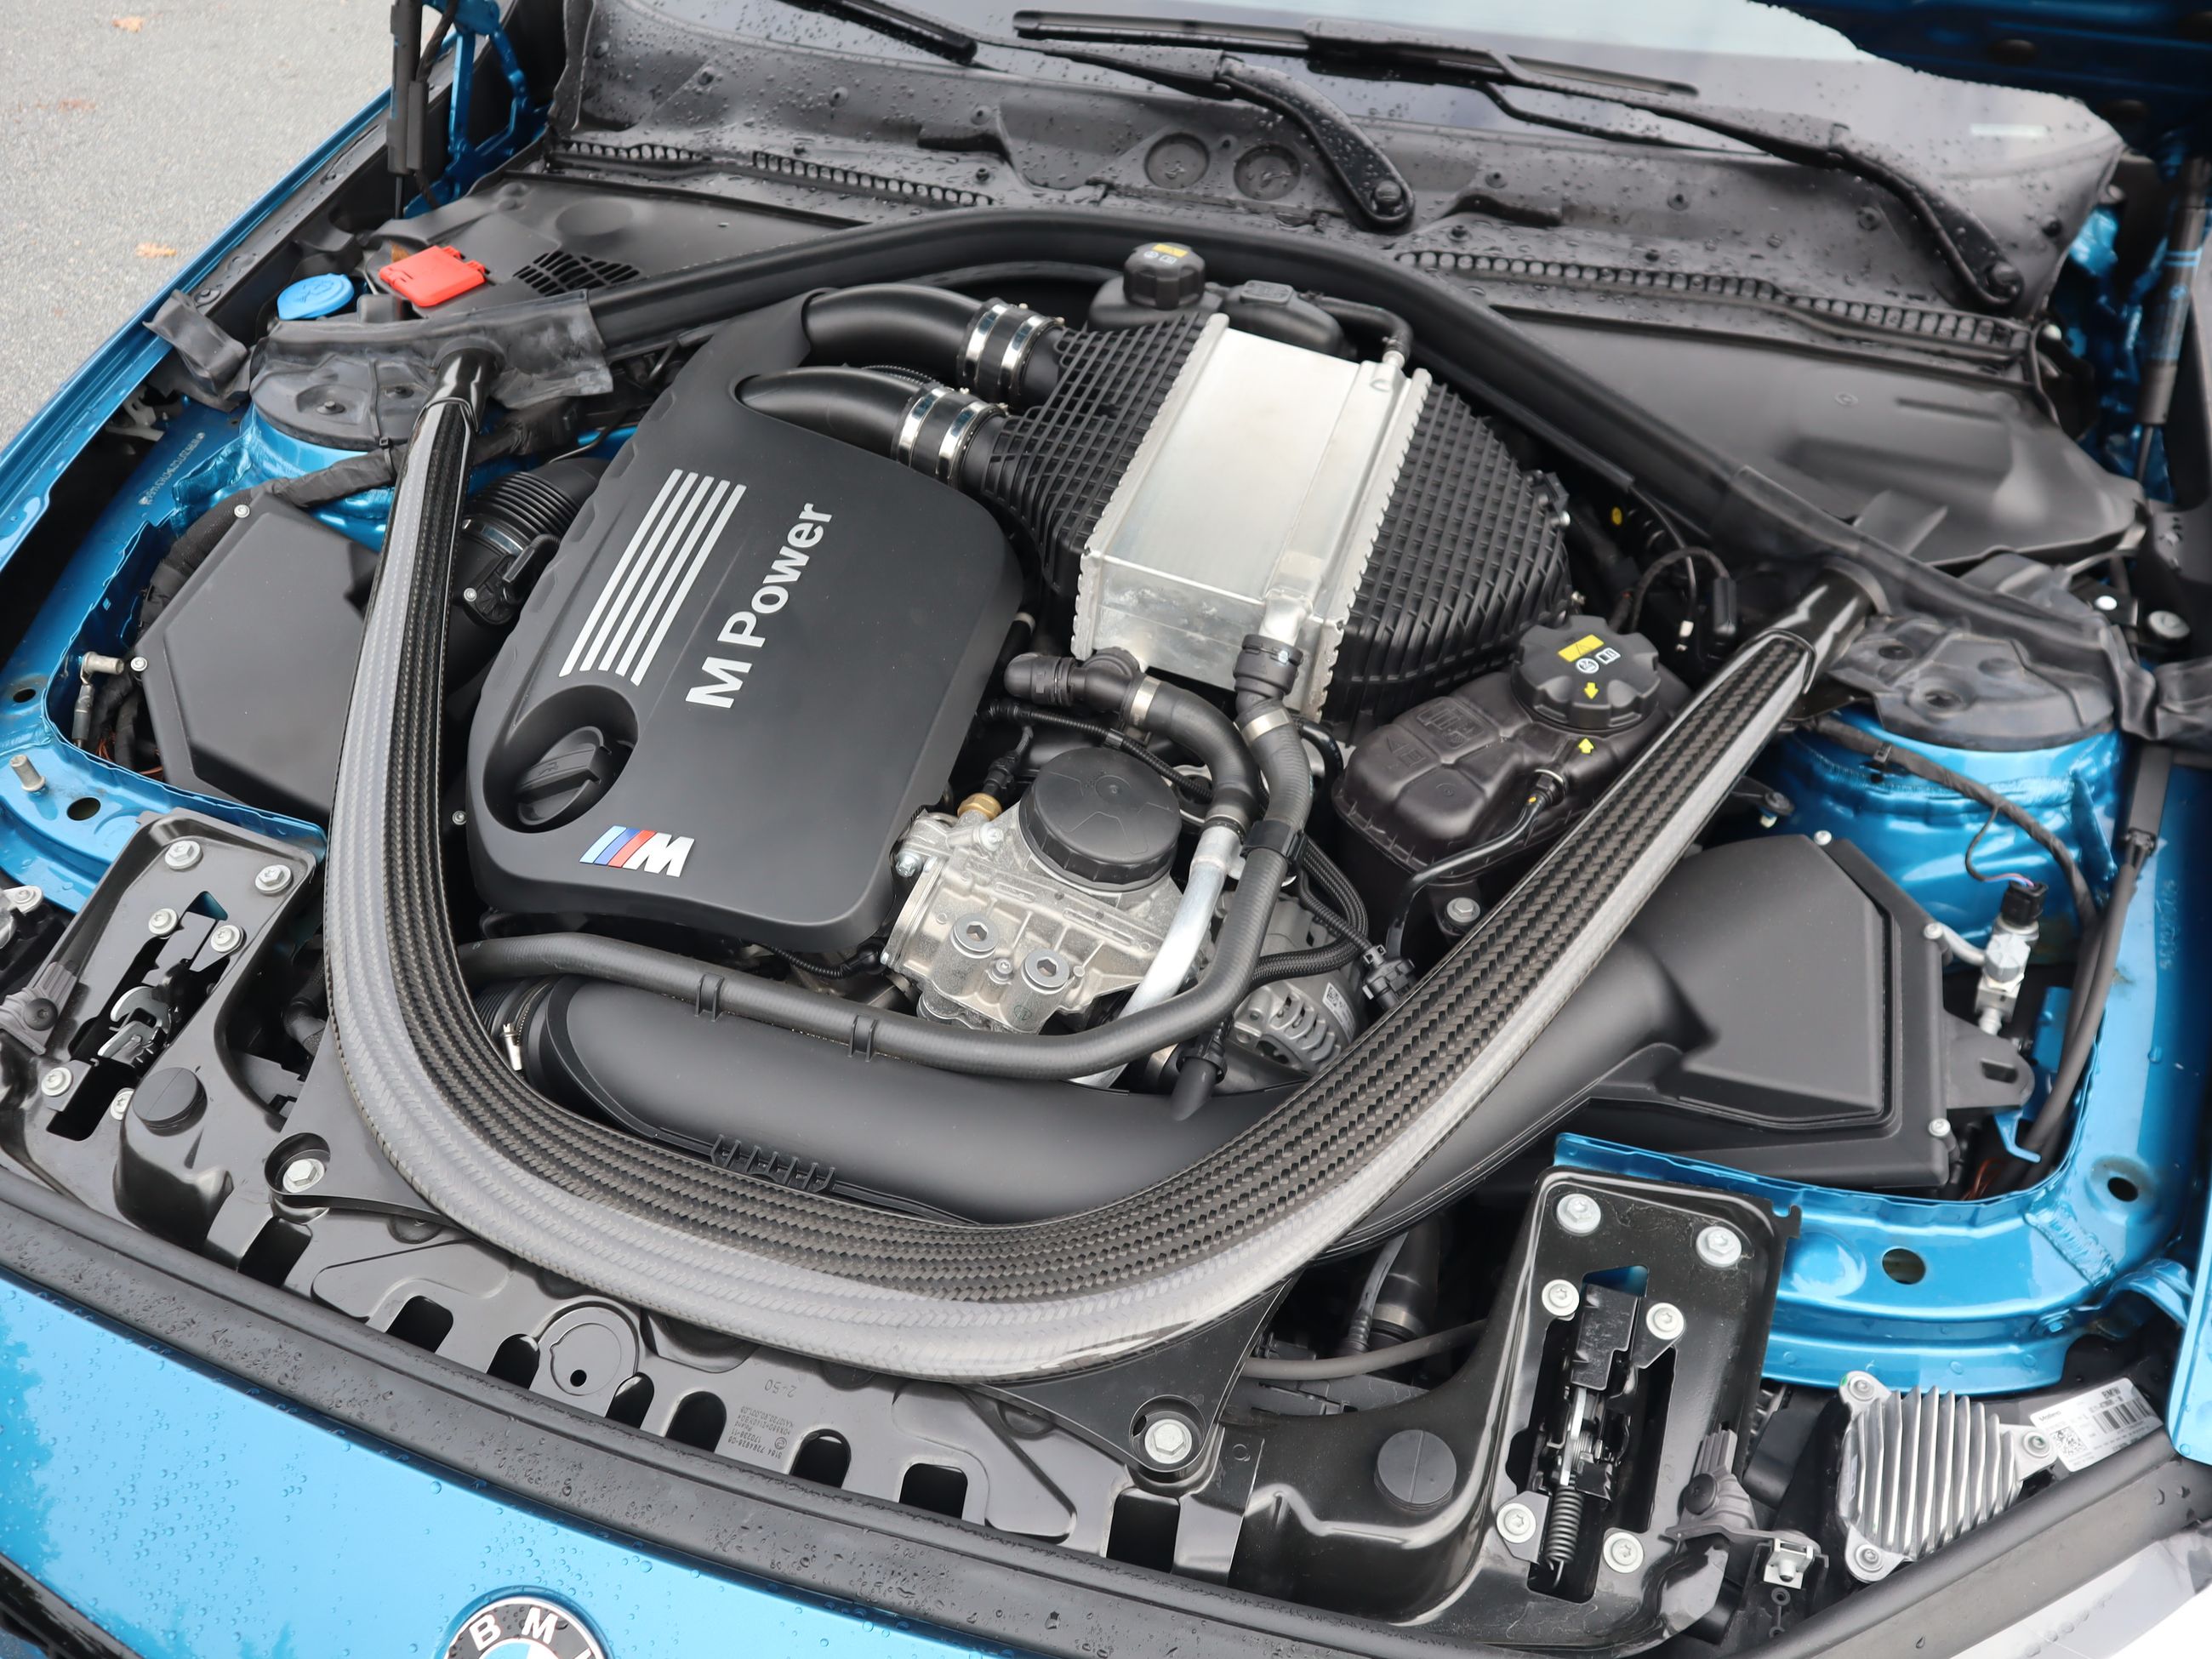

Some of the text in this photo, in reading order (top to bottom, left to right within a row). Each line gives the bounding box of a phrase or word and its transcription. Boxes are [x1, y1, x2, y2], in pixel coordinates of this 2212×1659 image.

[686, 503, 833, 708] M Power
[623, 833, 695, 877] M
